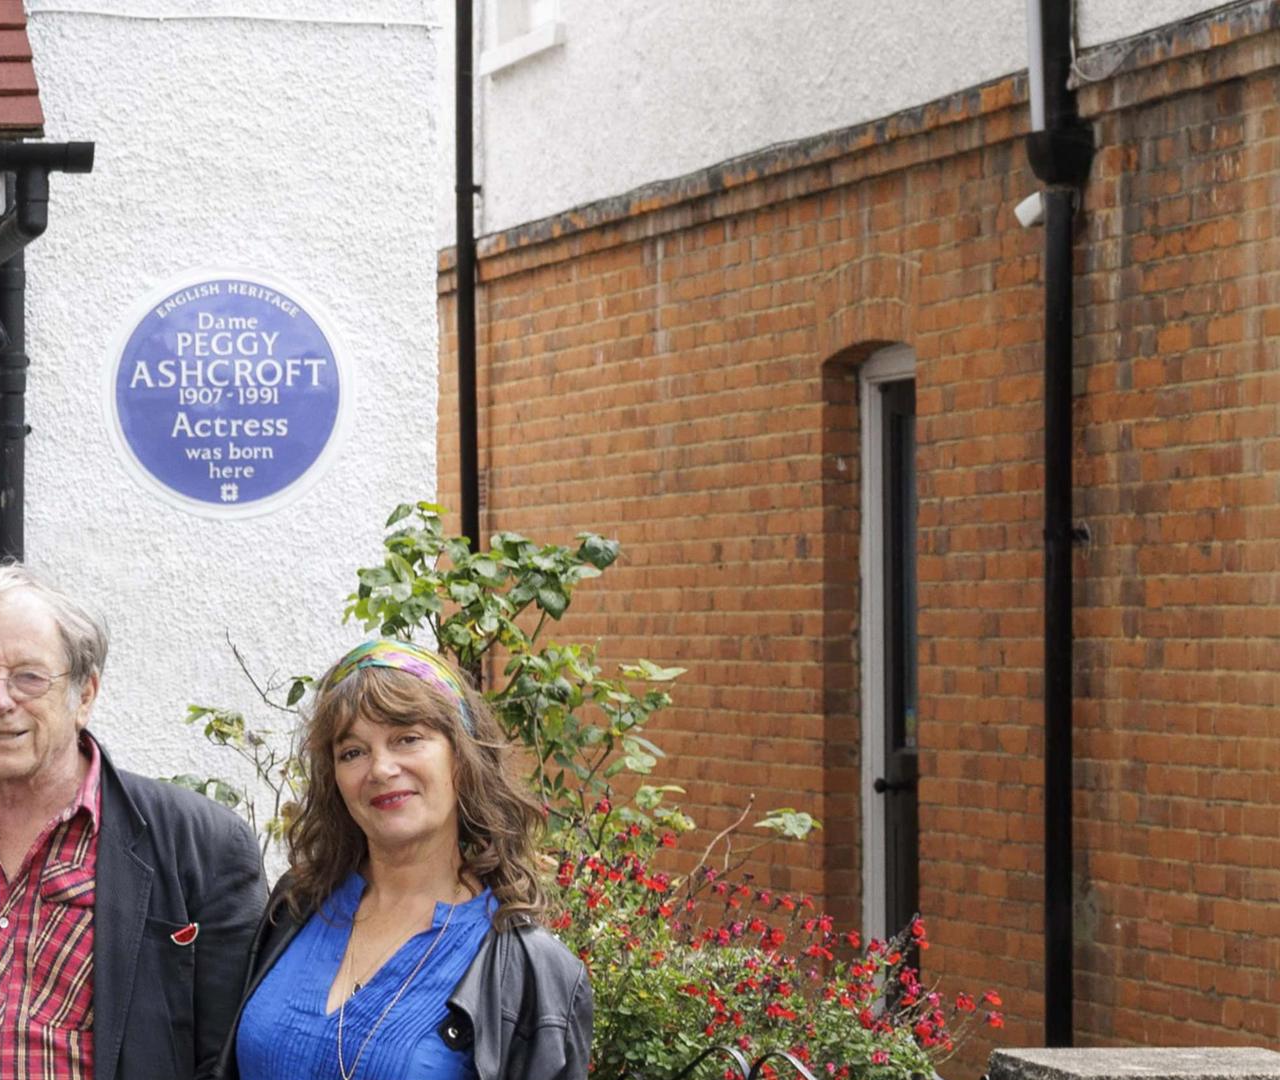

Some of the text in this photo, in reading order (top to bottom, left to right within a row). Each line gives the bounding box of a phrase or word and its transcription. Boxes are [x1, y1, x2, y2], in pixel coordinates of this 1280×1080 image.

[155, 283, 301, 319] ENGLISH HERITAGE
[197, 312, 258, 330] Dame
[176, 331, 280, 356] PEGGY
[130, 358, 327, 389] ASHCROFT
[171, 411, 288, 438] Actress
[185, 441, 274, 460] was born
[209, 461, 255, 479] here
